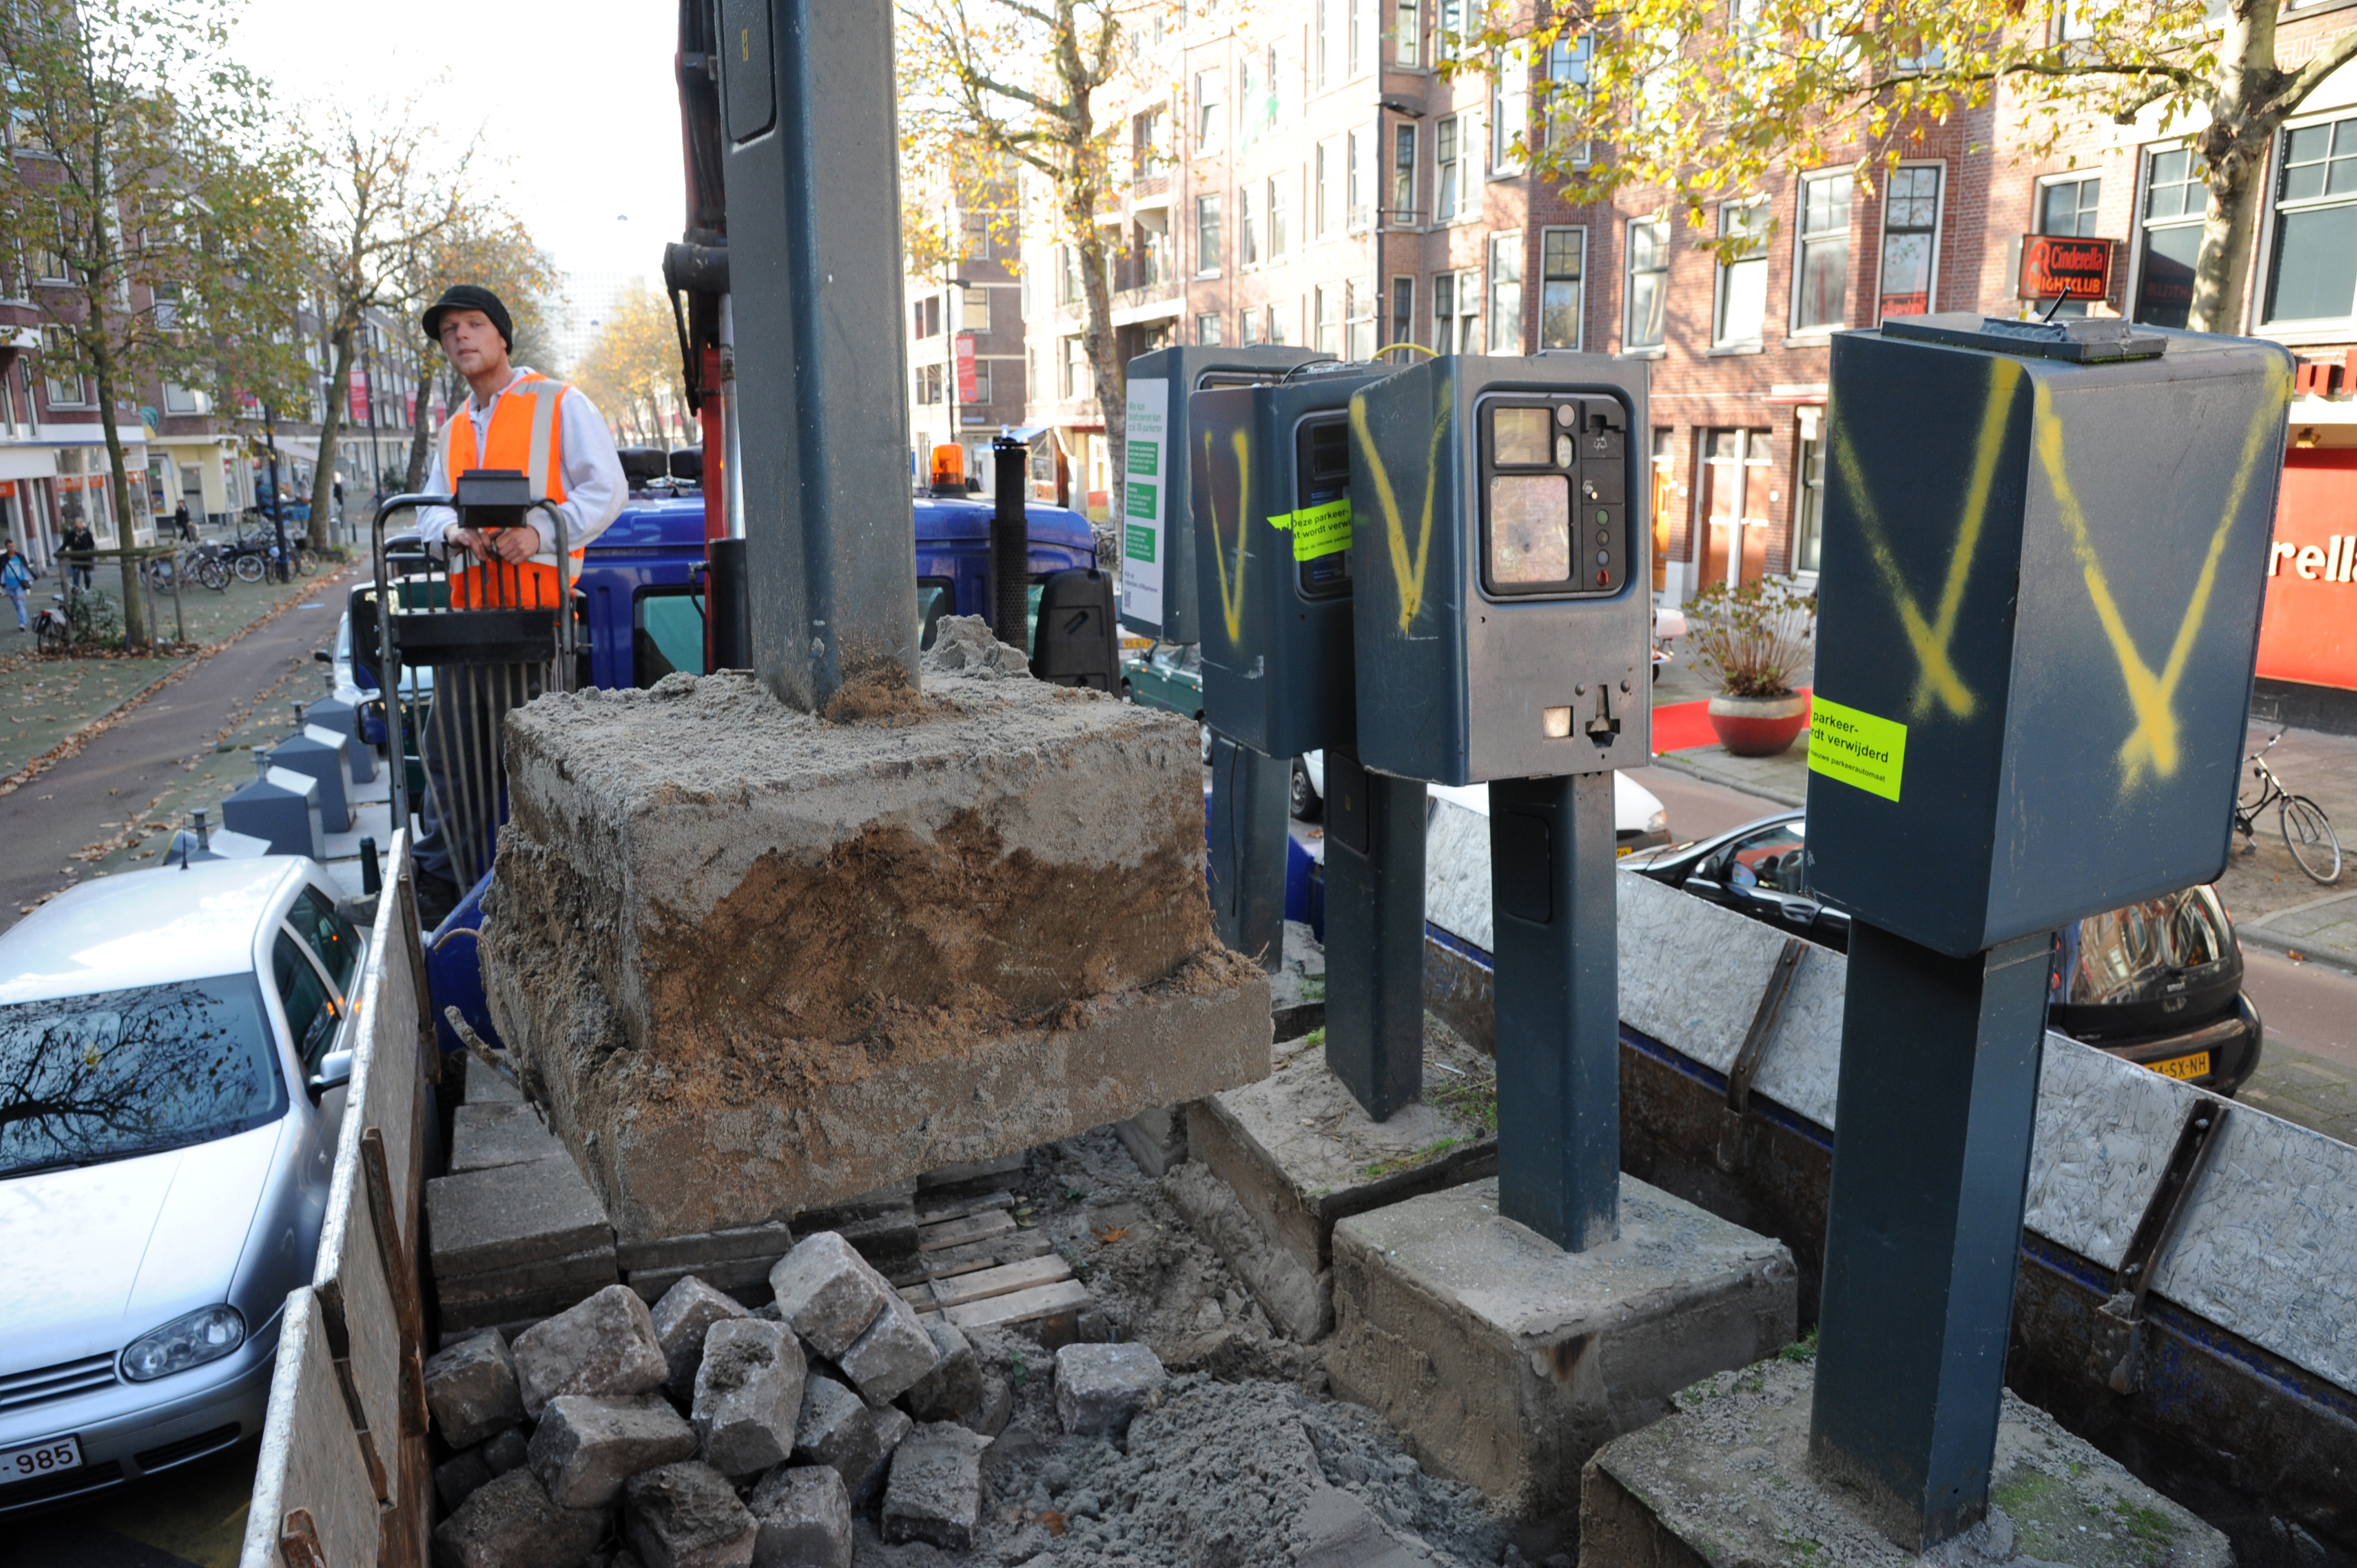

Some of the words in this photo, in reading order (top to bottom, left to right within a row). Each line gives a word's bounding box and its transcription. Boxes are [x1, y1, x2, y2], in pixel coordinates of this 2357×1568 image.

[2051, 245, 2103, 271] Cinderella
[2029, 271, 2101, 293] NIGHTCLUB
[1293, 518, 1312, 528] Deze
[1315, 509, 1349, 525] parkeer-
[1303, 525, 1326, 538] wordt
[2269, 535, 2357, 582] rell
[1813, 711, 1859, 733] parkeer-
[1810, 728, 1824, 741] rdt
[1828, 734, 1888, 764] verwijderd
[1810, 749, 1830, 762] nieuwe
[1831, 757, 1886, 782] parkeerautomaat
